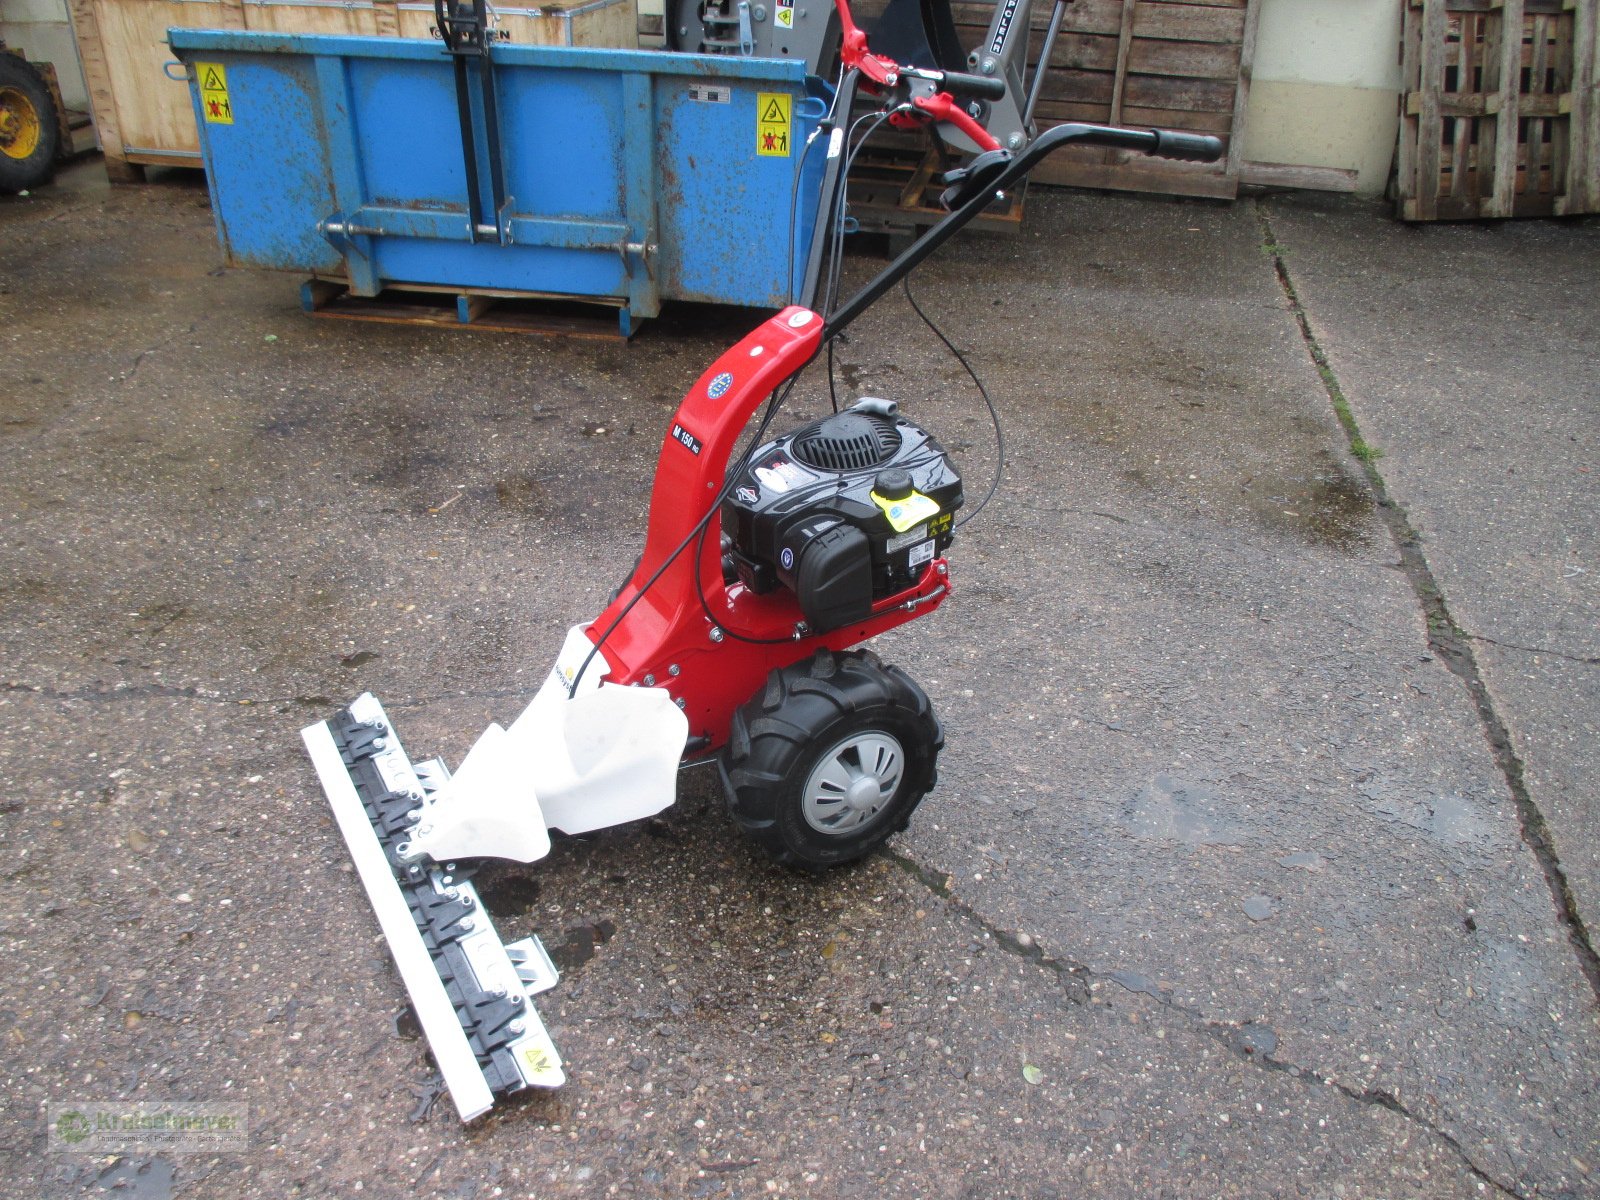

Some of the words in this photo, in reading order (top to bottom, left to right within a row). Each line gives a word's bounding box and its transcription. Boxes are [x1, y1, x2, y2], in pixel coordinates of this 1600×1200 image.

[992, 0, 1018, 53] PCLEAR
[672, 424, 682, 438] M
[681, 431, 694, 448] 150
